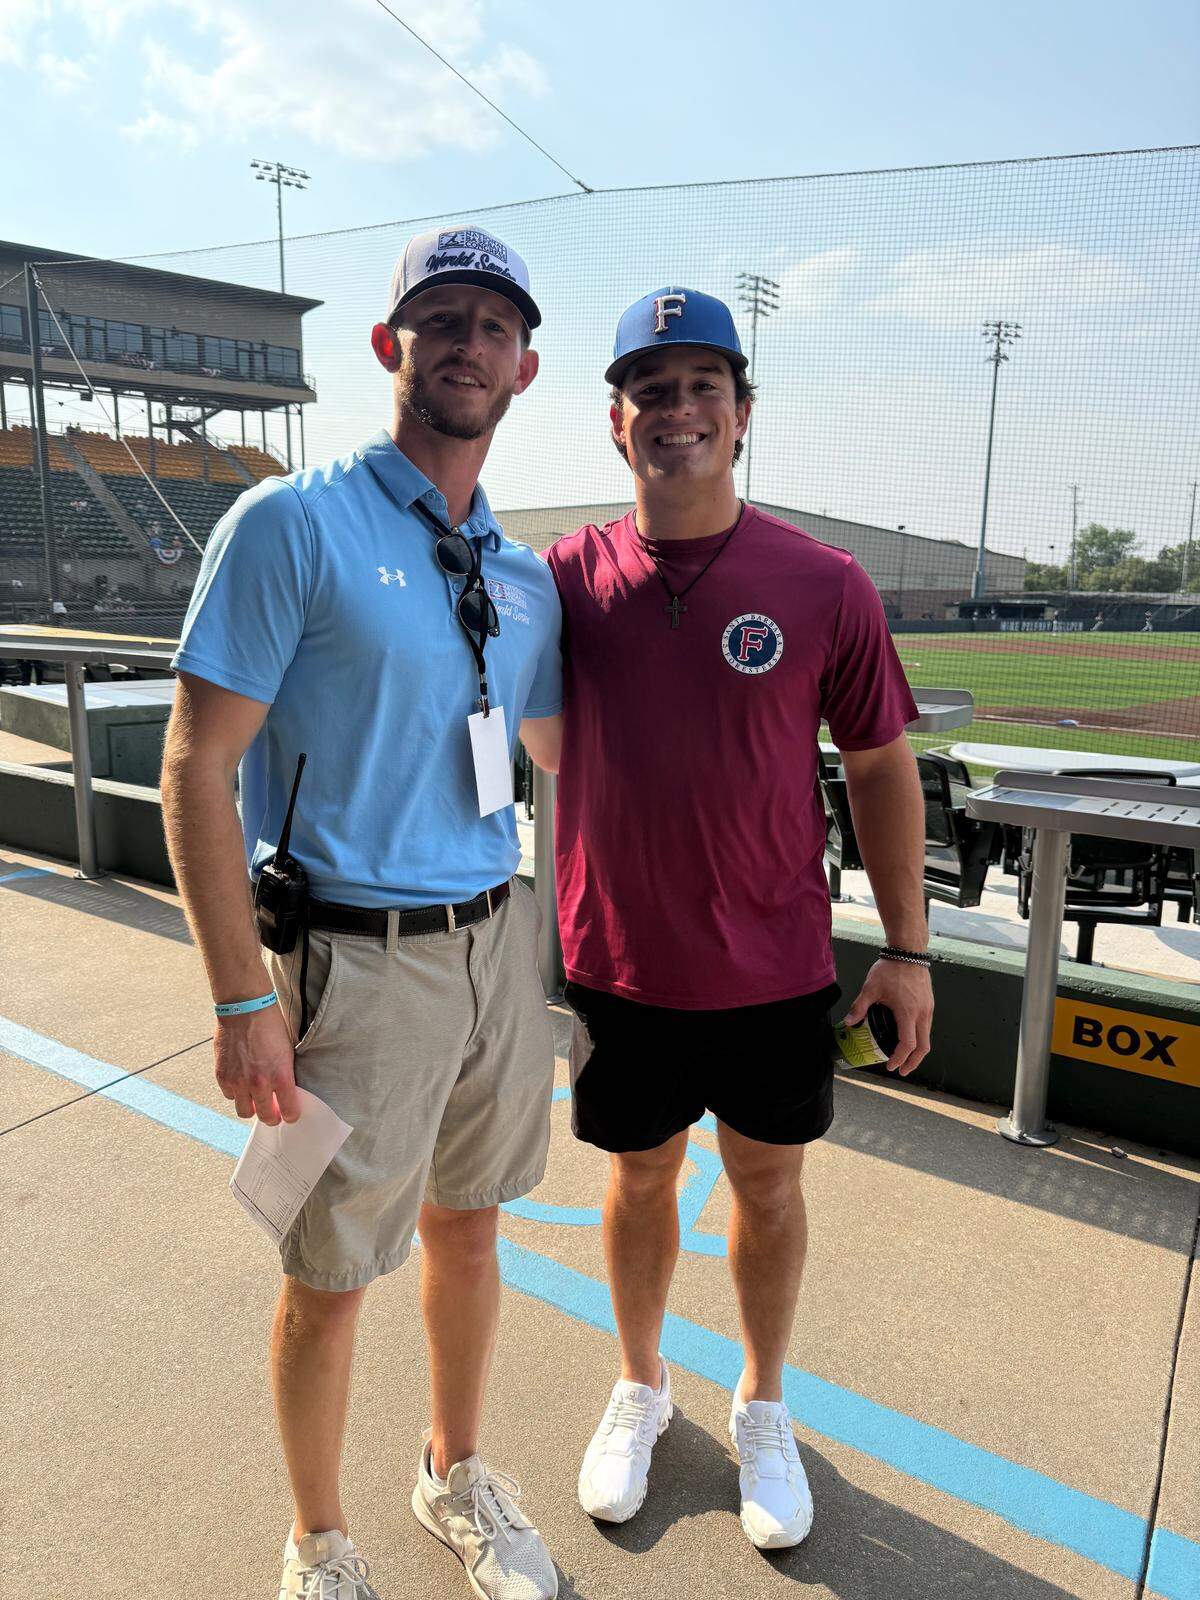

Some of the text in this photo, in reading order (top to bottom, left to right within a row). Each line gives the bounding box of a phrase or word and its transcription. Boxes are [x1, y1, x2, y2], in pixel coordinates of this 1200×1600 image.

[425, 251, 475, 272] World
[652, 293, 686, 335] F
[723, 614, 783, 646] SANTA BARBARA
[736, 626, 769, 661] F
[724, 653, 779, 673] FORESTERS
[1072, 1015, 1179, 1067] BOX
